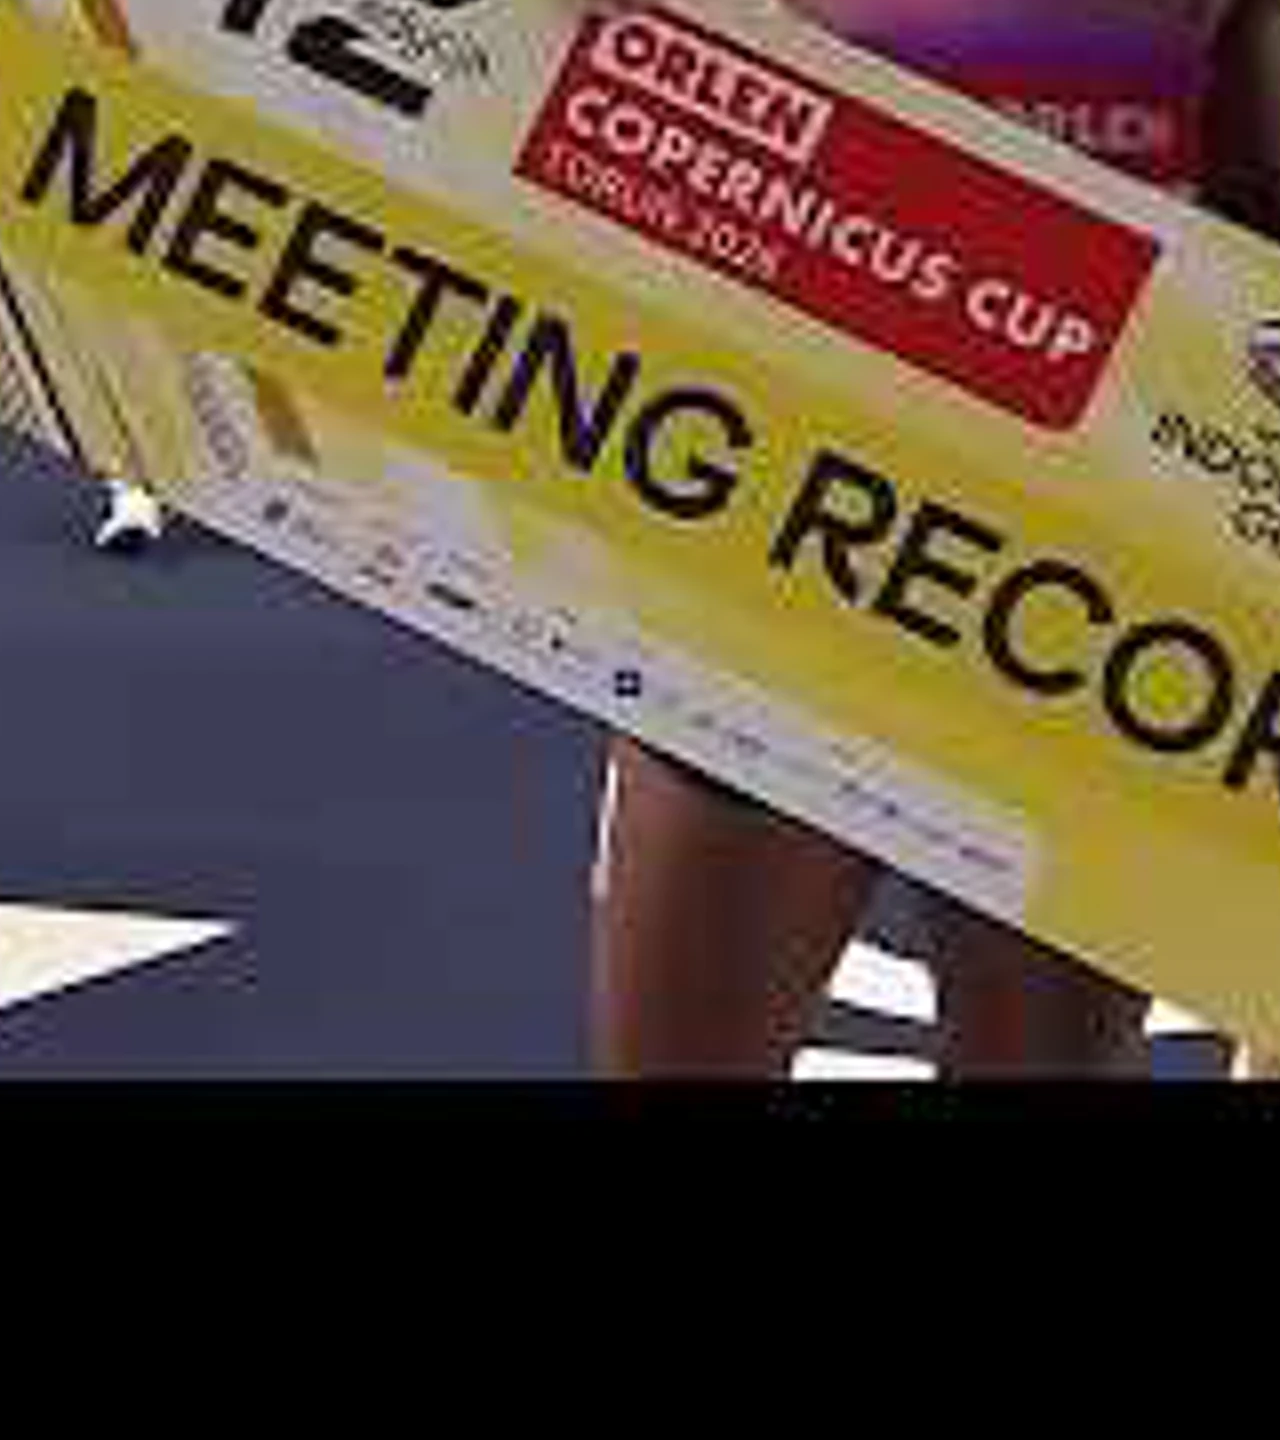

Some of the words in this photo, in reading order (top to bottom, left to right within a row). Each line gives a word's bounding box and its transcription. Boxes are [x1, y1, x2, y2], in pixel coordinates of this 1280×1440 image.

[564, 85, 960, 301] COPERNICUS
[966, 282, 1096, 362] CUP
[611, 23, 812, 157] ORLEN
[20, 86, 753, 520] MEETING
